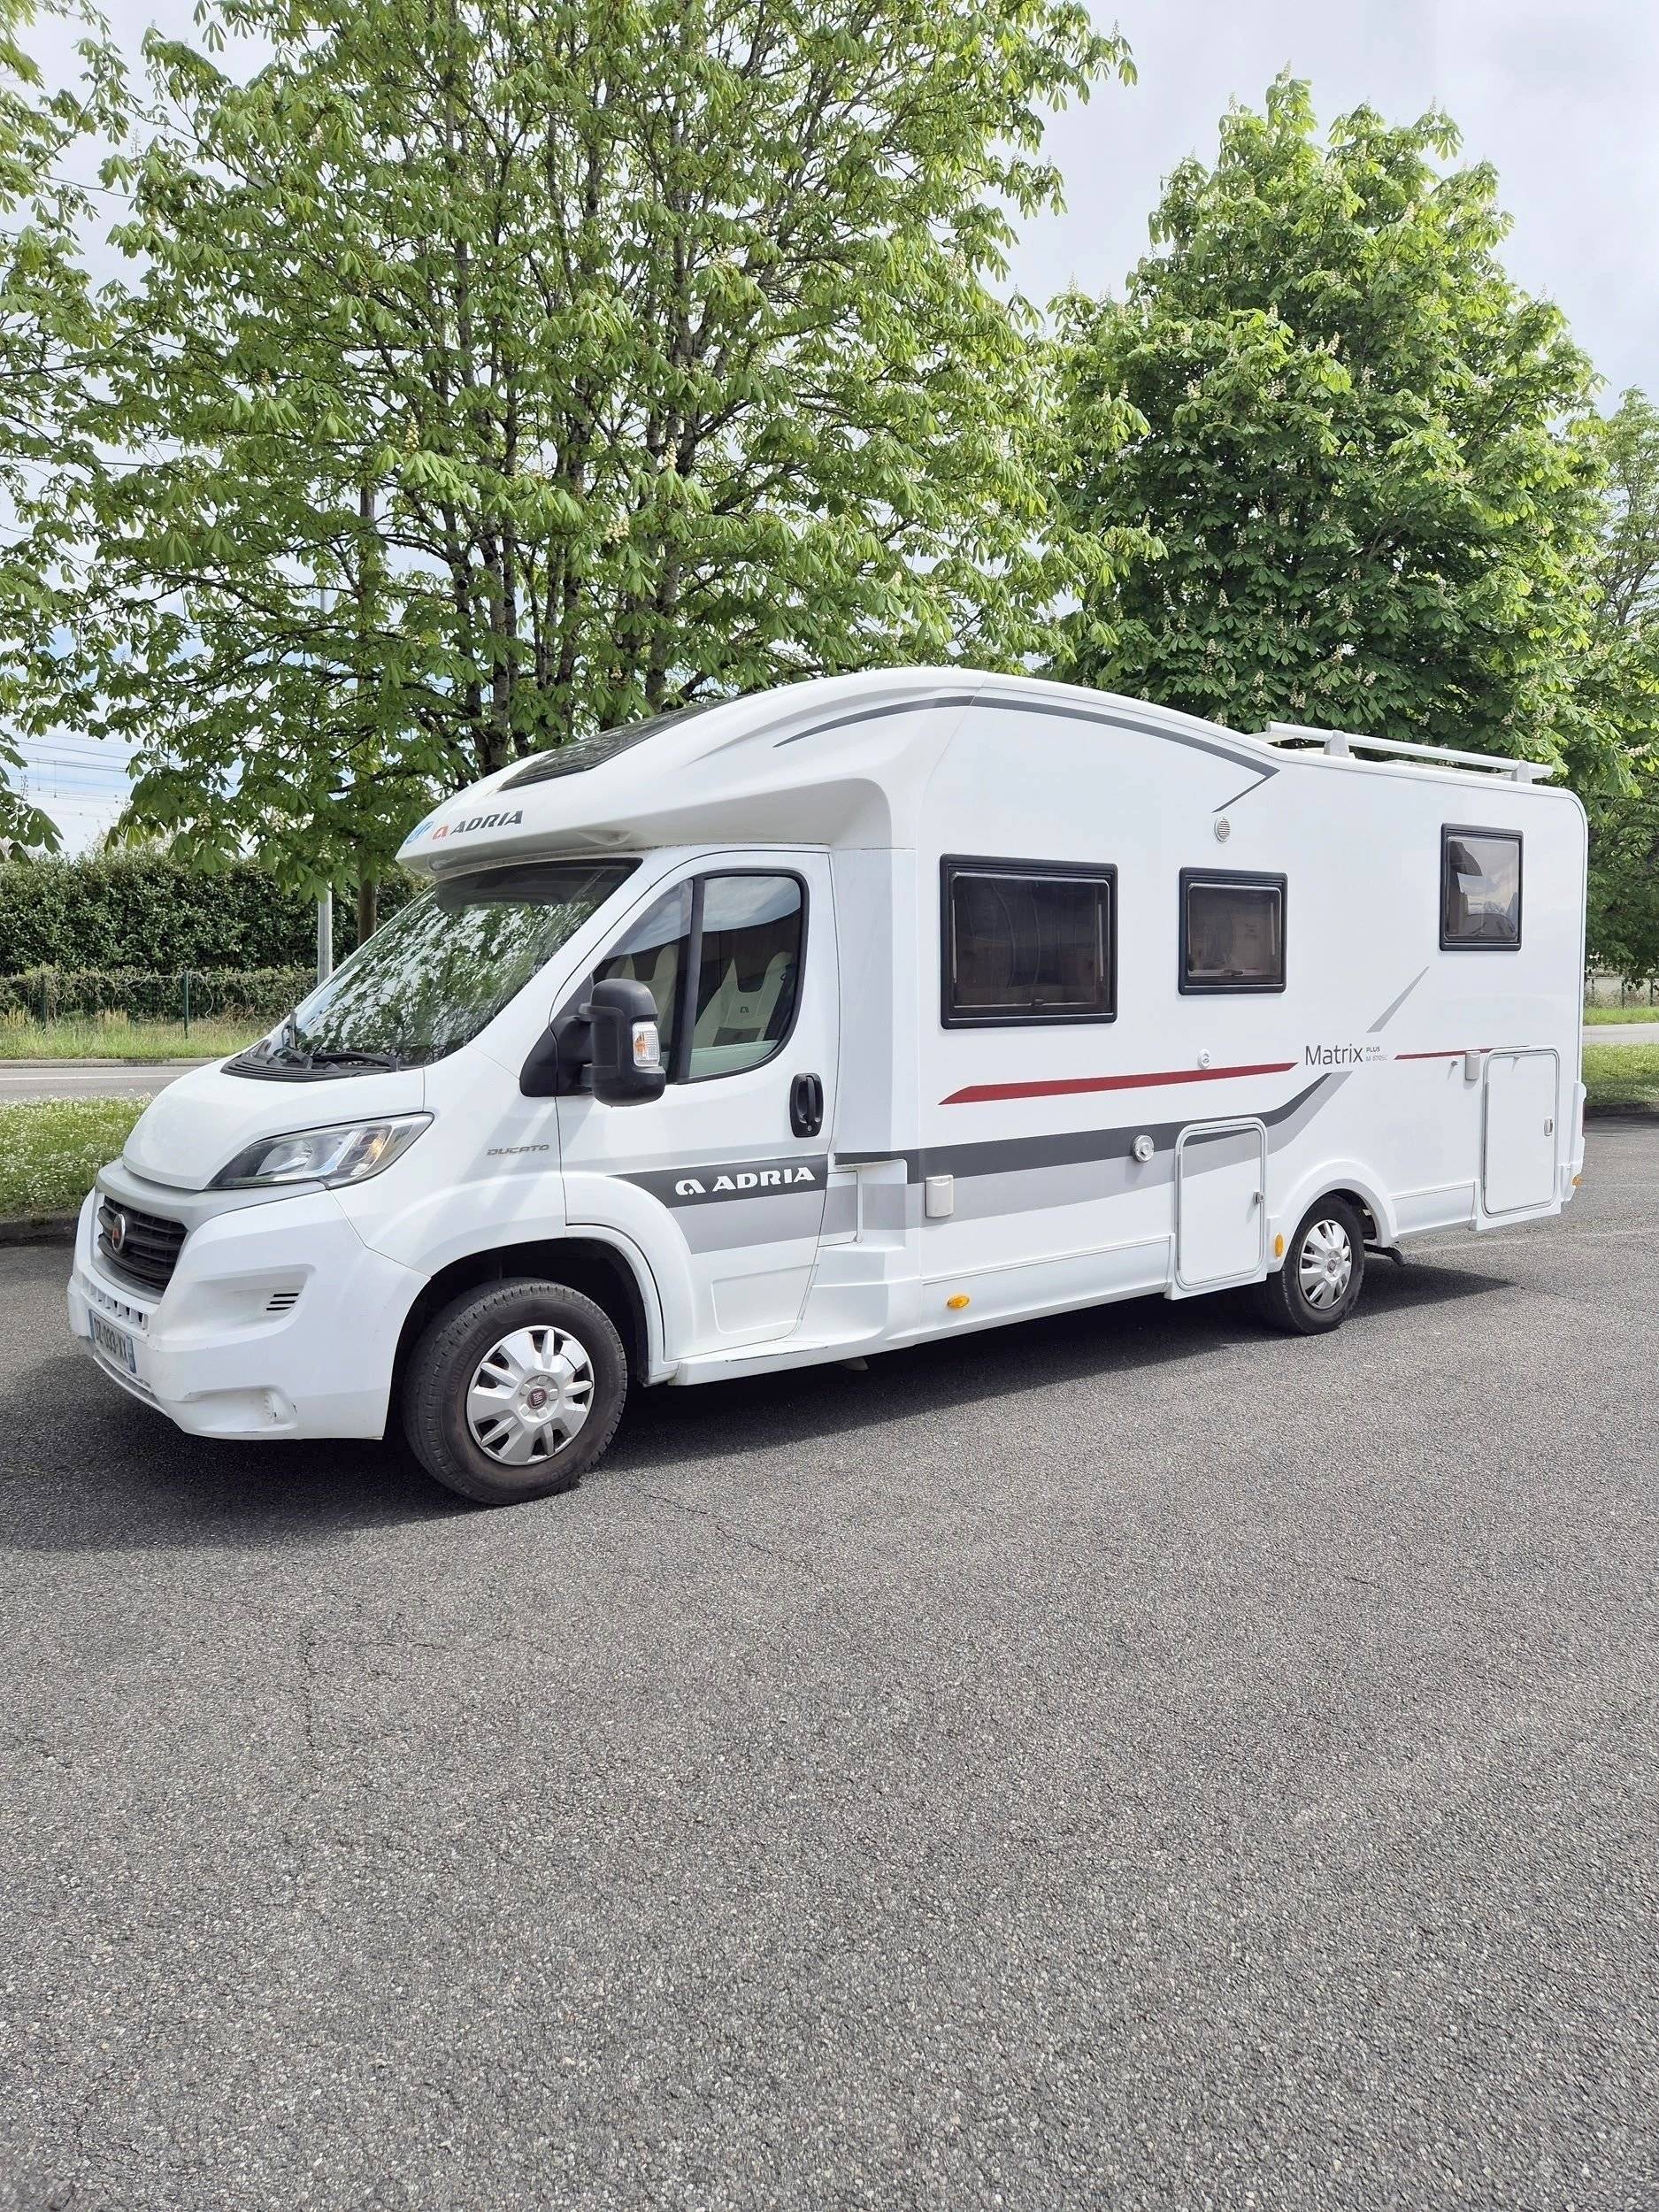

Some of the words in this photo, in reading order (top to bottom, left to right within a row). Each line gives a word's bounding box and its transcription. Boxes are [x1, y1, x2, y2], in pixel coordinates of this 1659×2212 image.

[449, 810, 524, 835] ADRIA
[1305, 1043, 1363, 1066] Matrix
[487, 1144, 550, 1156] DUCATO
[711, 1166, 816, 1193] ADRIA
